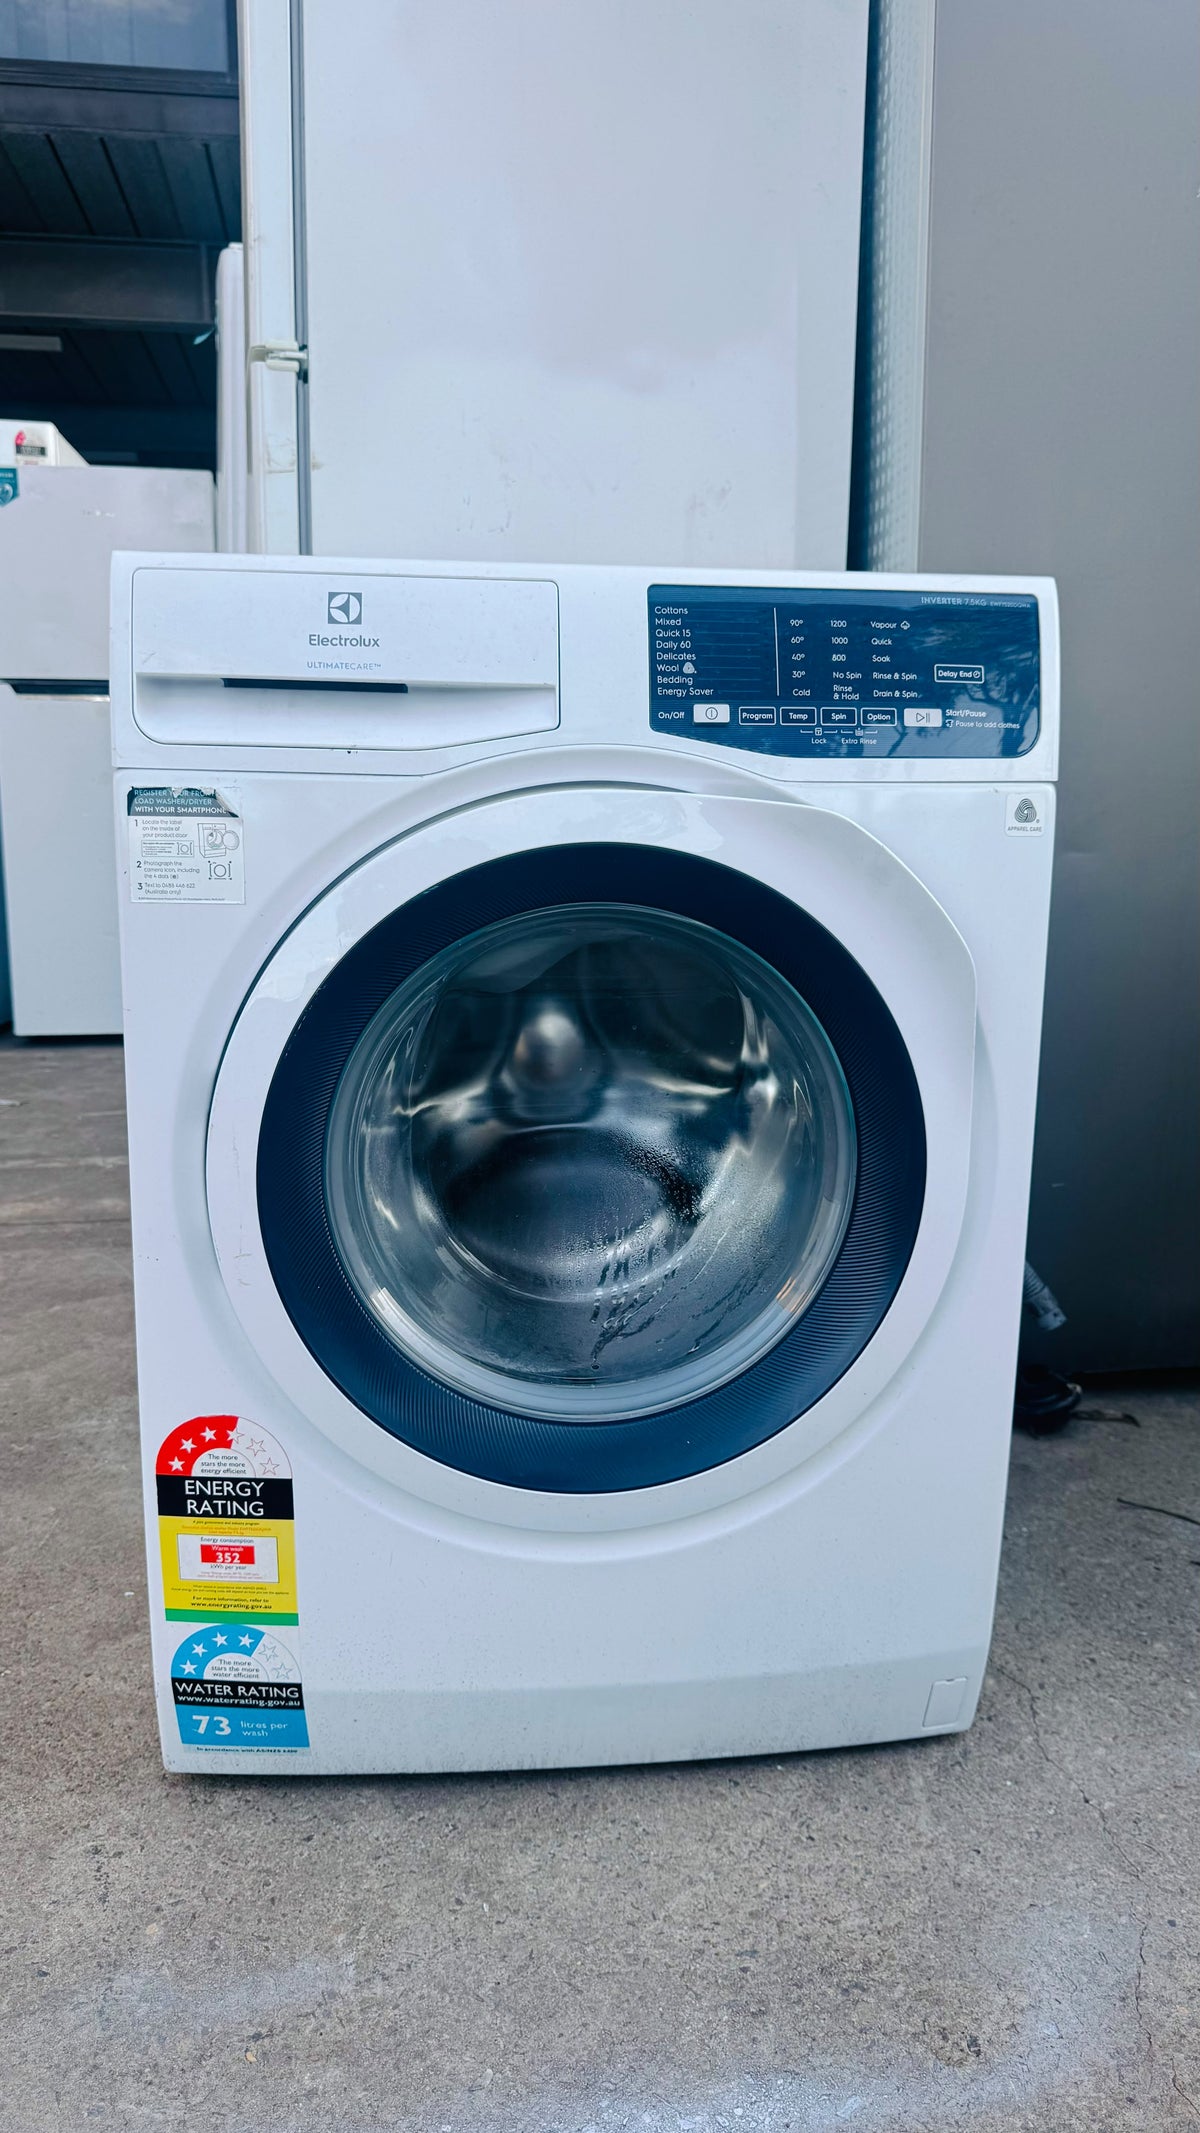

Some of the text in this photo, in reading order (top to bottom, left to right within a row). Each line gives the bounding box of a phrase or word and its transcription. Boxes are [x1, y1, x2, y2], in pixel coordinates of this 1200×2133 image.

[921, 596, 962, 605] INVERTER
[656, 629, 680, 637] Quick
[309, 634, 380, 647] Electrolux
[656, 641, 677, 650] Daily
[658, 676, 693, 685] Bedding
[846, 672, 861, 680] Spin
[658, 688, 687, 697] Energy
[658, 712, 684, 720] On/Off
[185, 1480, 264, 1496] ENERGY
[187, 1500, 264, 1516] RATING
[216, 1552, 240, 1563] 352
[175, 1682, 299, 1698] WATER RATING
[178, 1695, 300, 1707] www.waterrating.gov.au
[192, 1715, 231, 1736] 73
